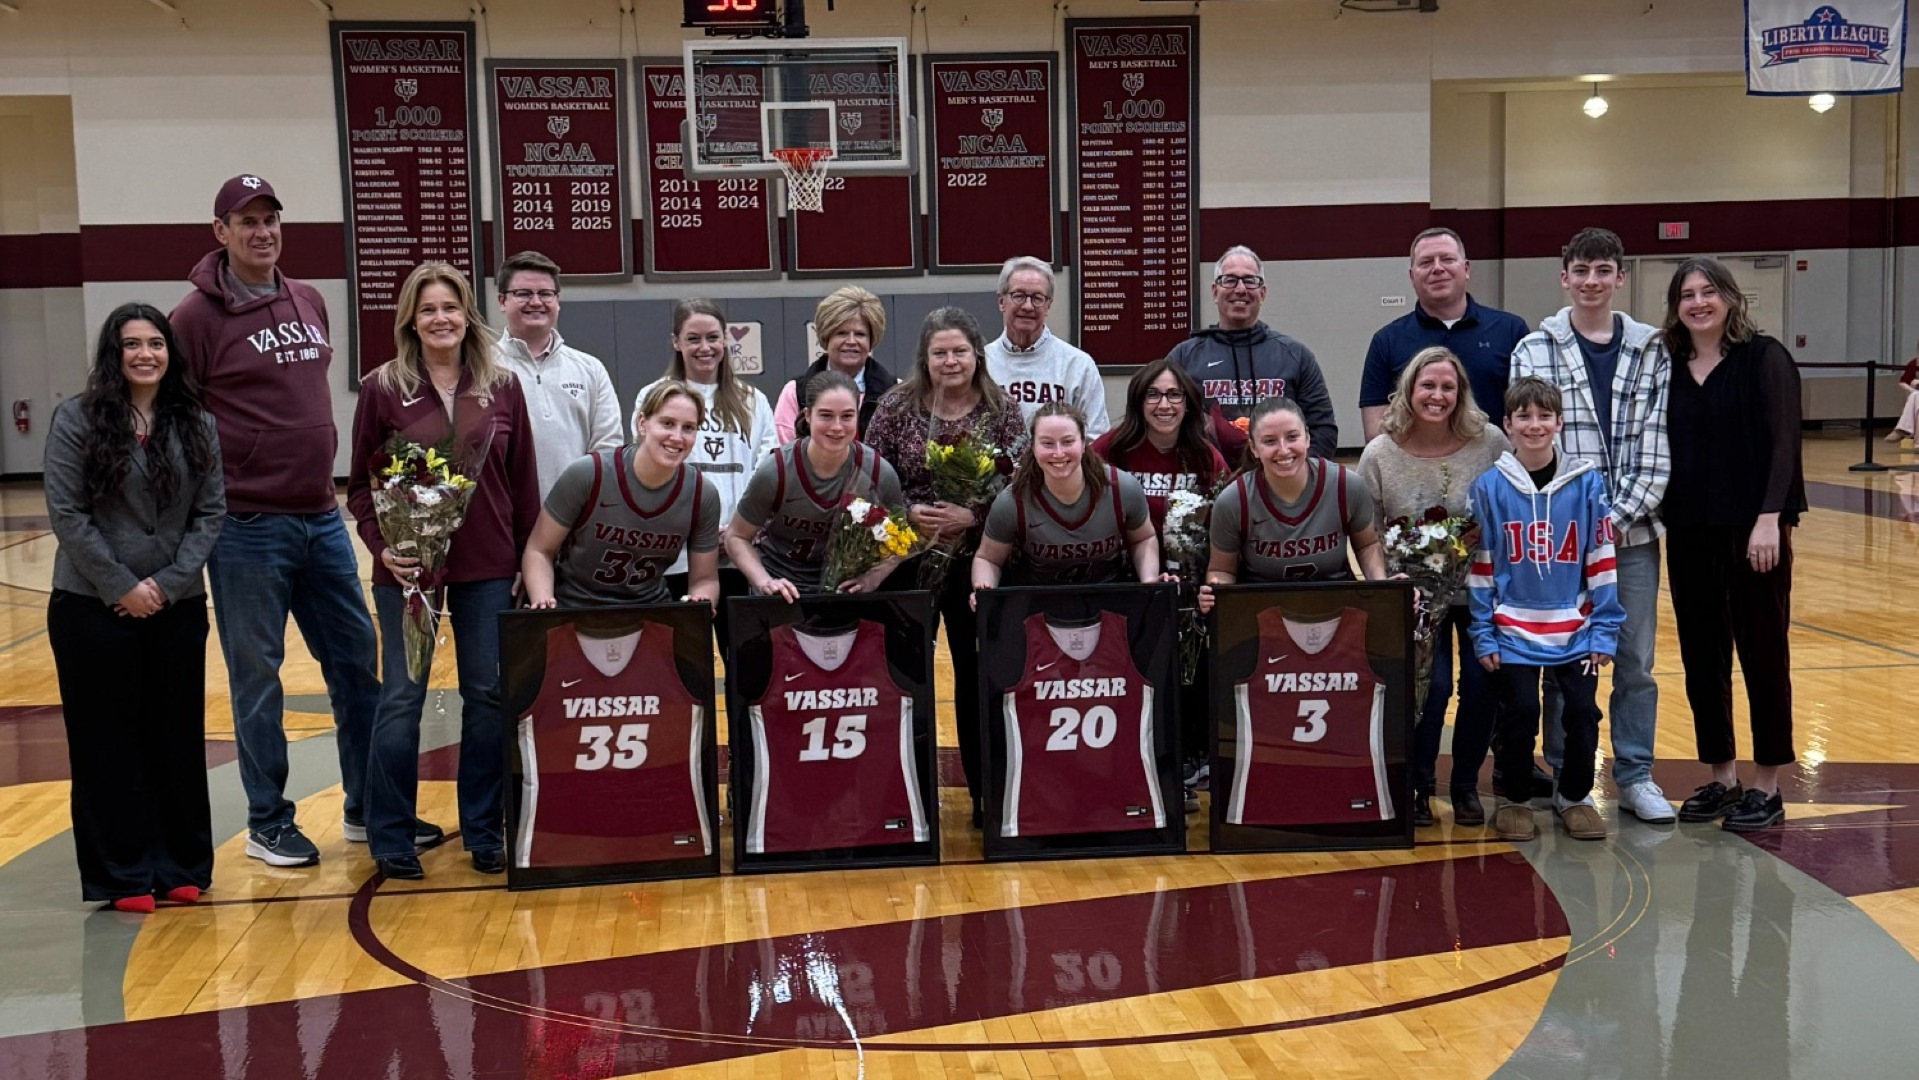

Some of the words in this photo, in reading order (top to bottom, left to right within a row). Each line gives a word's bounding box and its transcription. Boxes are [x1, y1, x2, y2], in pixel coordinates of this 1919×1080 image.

[1080, 34, 1186, 56] VASSAR
[1764, 26, 1827, 46] LIBERTY
[1831, 25, 1888, 43] LEAGUE
[346, 39, 461, 60] VASSAR
[349, 65, 398, 73] WOMEN'S
[401, 65, 461, 73] BASKETBALL
[1089, 61, 1118, 69] MEN'S
[1120, 60, 1177, 68] BASKETBALL
[500, 77, 612, 98] VASSAR
[938, 70, 1045, 92] VASSAR
[504, 102, 549, 110] WOMENS
[551, 102, 610, 110] BASKETBALL
[947, 96, 977, 104] MEN'S
[979, 95, 1036, 104] BASKETBALL
[1104, 99, 1165, 120] 1,000
[374, 106, 441, 128] 1,000
[1081, 122, 1123, 134] POINT
[1125, 121, 1186, 133] SCORERS
[352, 130, 398, 141] POINT
[400, 129, 464, 141] SCORERS
[959, 134, 1027, 154] NCAA
[523, 143, 595, 162] NCAA
[942, 156, 1046, 169] TOURNAMENT
[506, 165, 614, 177] TOURNAMENT
[947, 173, 987, 187] 2022
[512, 182, 552, 195] 2011
[571, 182, 610, 195] 2012
[659, 179, 700, 192] 2011
[717, 178, 758, 191] 2012
[513, 200, 553, 212] 2014
[571, 200, 611, 212] 2019
[660, 197, 701, 210] 2014
[718, 196, 759, 208] 2024
[513, 217, 554, 230] 2024
[571, 217, 612, 230] 2025
[661, 215, 702, 227] 2025
[247, 321, 329, 353] VASSAR
[299, 347, 320, 361] 1861
[594, 522, 683, 550] VASSAR
[1254, 531, 1339, 559] VASSAR
[1502, 520, 1580, 564] USA
[1031, 535, 1117, 561] VASSAR
[593, 550, 668, 586] 35
[1034, 677, 1126, 700] VASSAR
[1265, 672, 1358, 692] VASSAR
[563, 695, 660, 718] VASSAR
[784, 687, 878, 711] VASSAR
[1045, 704, 1118, 750] 20
[1292, 699, 1331, 742] 3
[574, 723, 650, 770] 35
[799, 714, 867, 762] 15
